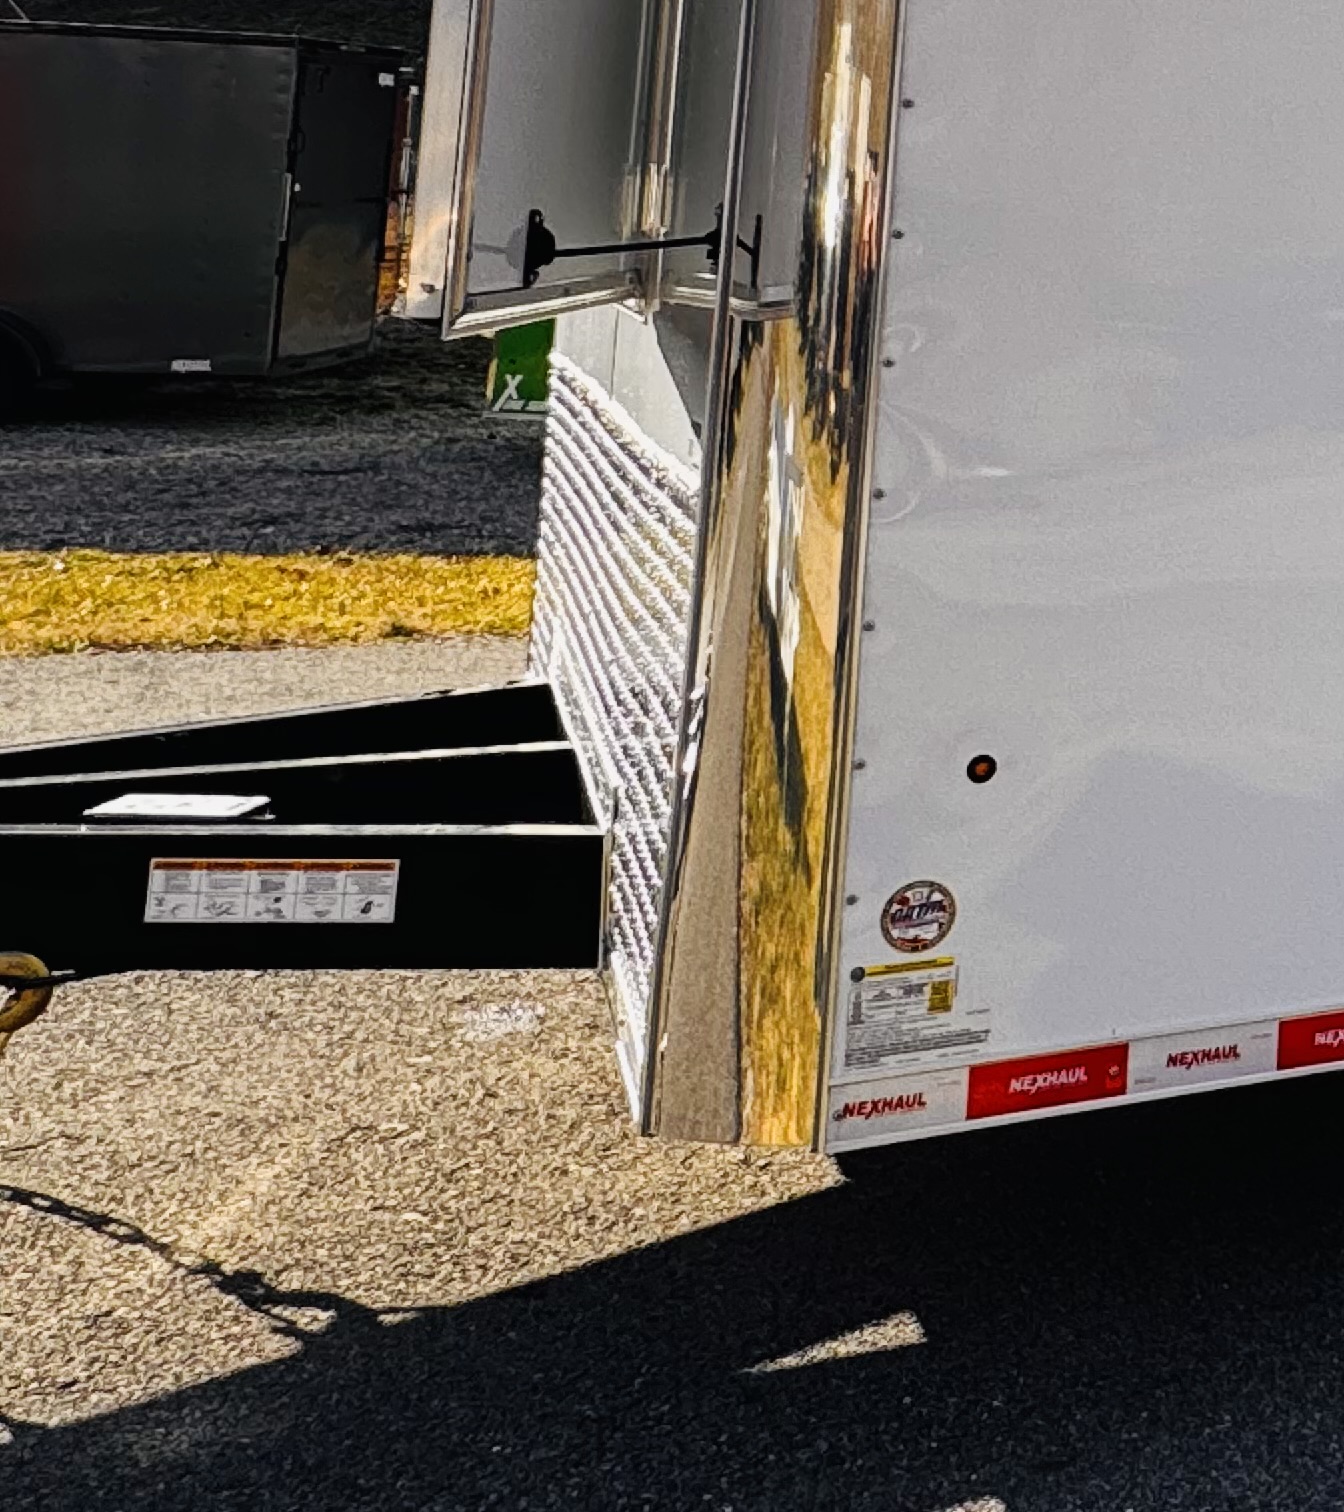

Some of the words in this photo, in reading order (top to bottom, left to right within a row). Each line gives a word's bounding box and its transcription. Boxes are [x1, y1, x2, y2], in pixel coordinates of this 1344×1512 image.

[1166, 1044, 1241, 1070] NEXHAUL
[1008, 1066, 1088, 1095] NEXHAUL
[842, 1092, 927, 1120] NEXHAUL
